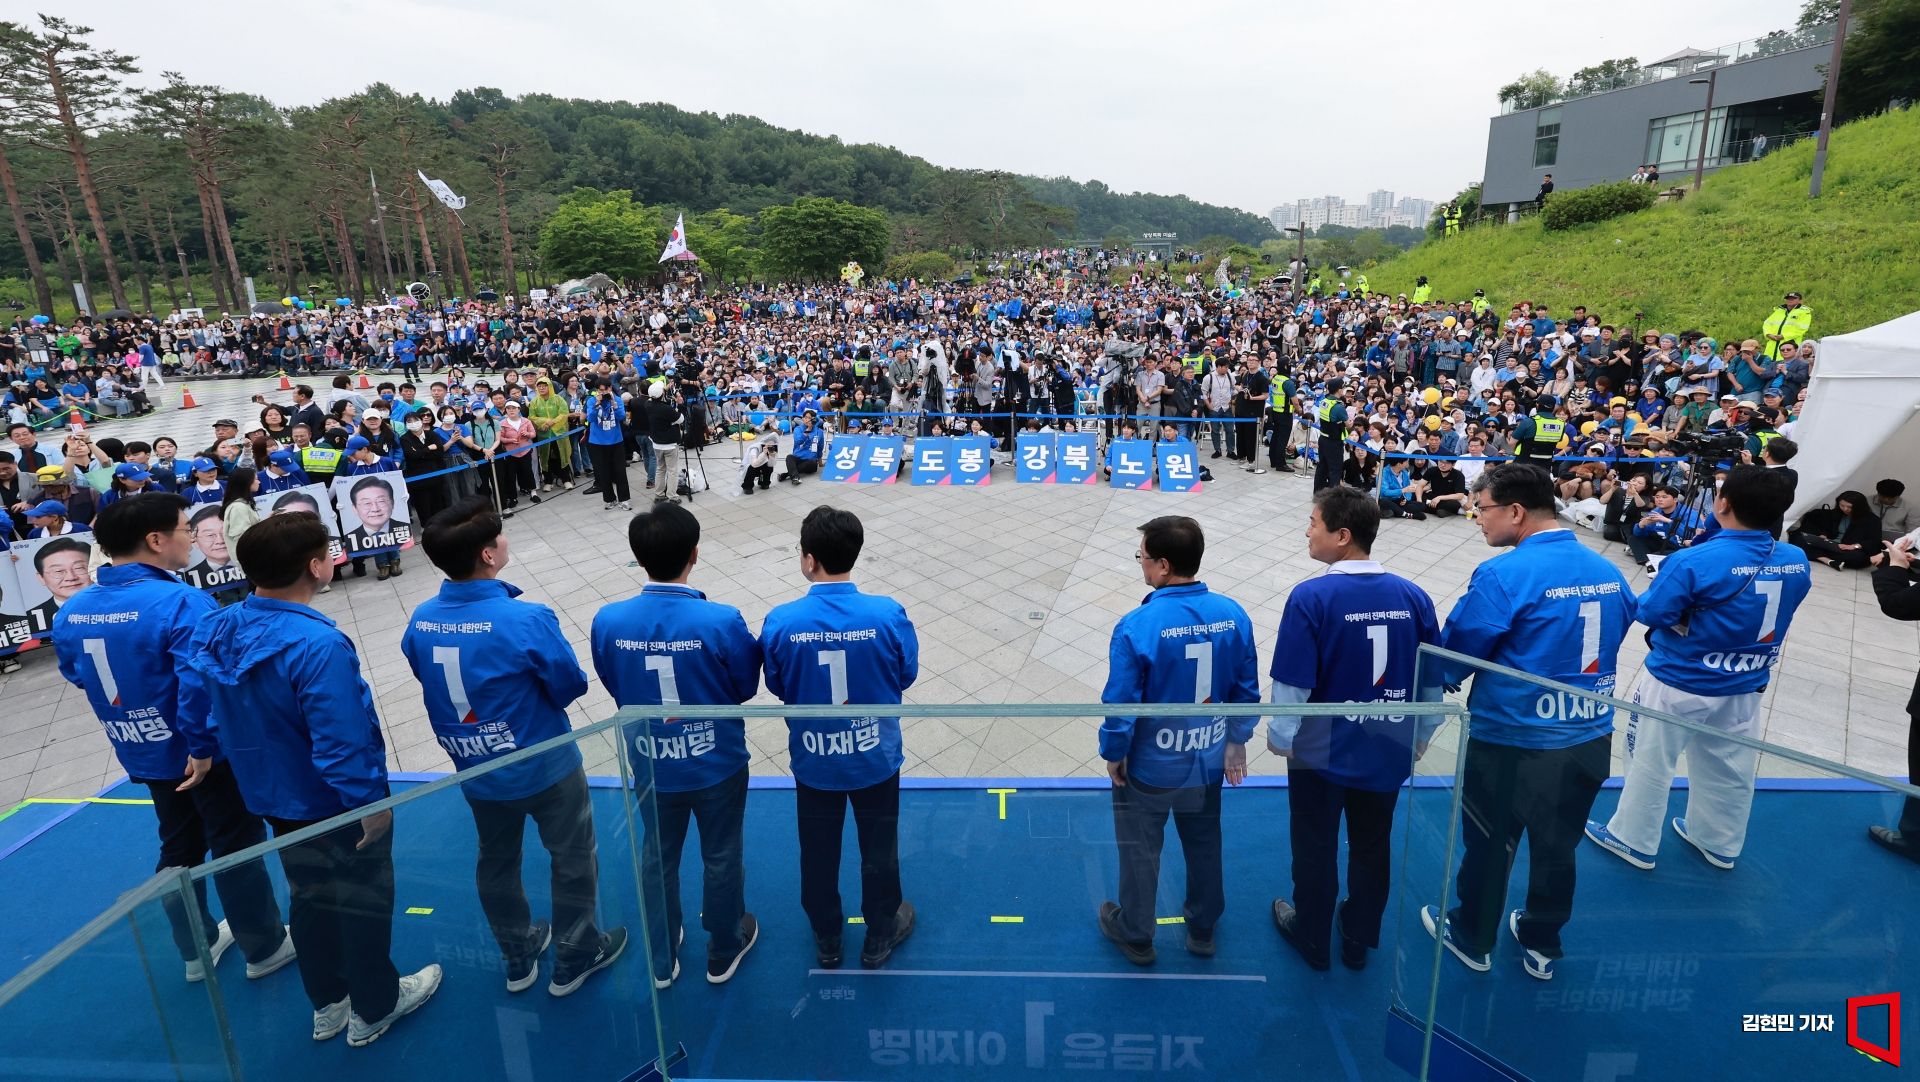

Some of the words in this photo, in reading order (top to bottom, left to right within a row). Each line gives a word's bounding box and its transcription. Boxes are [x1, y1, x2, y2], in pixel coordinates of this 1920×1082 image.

[834, 446, 895, 472] 성북
[918, 448, 984, 473] 도봉
[1023, 444, 1090, 471] 강북
[347, 533, 359, 552] 1
[361, 530, 410, 549] 이재명
[188, 570, 203, 589] 1
[206, 566, 247, 586] 이재
[1763, 565, 1782, 576] 진짜
[1782, 563, 1806, 575] 대한민국
[1545, 586, 1580, 600] 이제부터
[1580, 585, 1596, 597] 진짜
[1596, 582, 1621, 595] 대한민국
[31, 608, 47, 631] 1
[90, 612, 105, 624] 진짜
[105, 611, 139, 623] 대한민국
[1344, 612, 1372, 622] 이제부터
[1371, 611, 1386, 621] 진짜
[1386, 609, 1411, 620] 대한민국
[1755, 580, 1783, 643] 1
[4, 619, 29, 630] 지금은
[416, 620, 441, 633] 이제부터
[441, 622, 458, 634] 진짜
[458, 621, 492, 634] 대한민국
[1160, 626, 1192, 639] 이제부터
[1192, 624, 1209, 636] 진짜
[1209, 619, 1236, 634] 대한민국
[615, 639, 648, 651] 이제부터
[649, 640, 667, 652] 진짜
[667, 639, 703, 652] 대한민국
[789, 632, 823, 644] 이제부터
[824, 631, 842, 642] 진짜
[843, 629, 877, 642] 대한민국
[1579, 601, 1601, 674] 1
[1366, 625, 1388, 686] 1
[83, 638, 121, 706] 1
[818, 650, 848, 705] 1
[1185, 641, 1213, 704] 1
[432, 646, 479, 724] 1
[645, 656, 681, 725] 1
[1383, 688, 1407, 698] 지금은
[125, 707, 160, 719] 지금은
[850, 716, 879, 729] 지금은
[100, 716, 173, 744] 이재명
[479, 720, 509, 734] 지금은
[682, 720, 714, 733] 지금은
[1155, 718, 1228, 752] 이재명
[438, 729, 518, 758] 이재명
[635, 728, 717, 759] 이재명
[801, 722, 881, 756] 이재명
